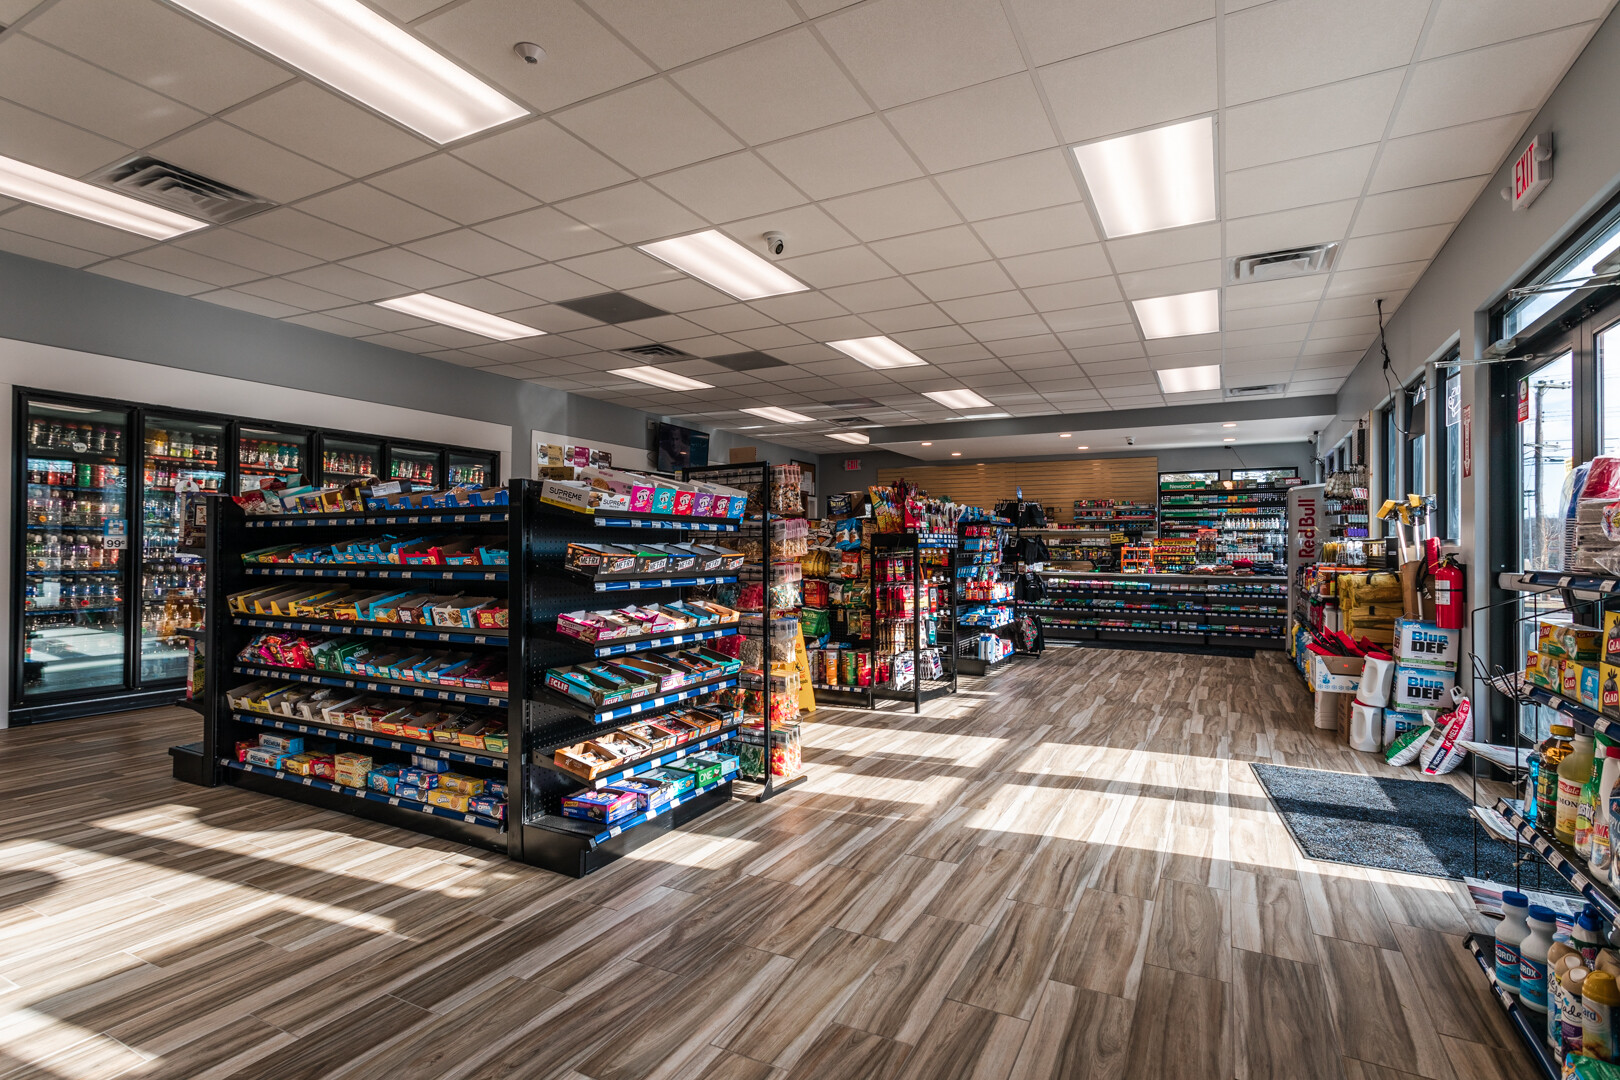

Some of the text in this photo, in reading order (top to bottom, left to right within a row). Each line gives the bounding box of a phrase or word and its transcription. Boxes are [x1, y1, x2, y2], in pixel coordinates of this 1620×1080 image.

[1515, 142, 1534, 200] EXIT
[847, 460, 858, 470] EXIT
[1169, 483, 1192, 491] Newport
[549, 486, 582, 501] SUPREME
[602, 499, 626, 507] SUPREME
[1298, 499, 1316, 558] Red Bull
[1412, 631, 1449, 645] Blue
[1540, 627, 1551, 637] GLAD
[1411, 641, 1447, 654] DEF
[1608, 639, 1620, 651] GLA
[1527, 656, 1537, 666] GLAD
[553, 679, 569, 692] CLIF
[1407, 676, 1445, 691] Blue
[1564, 678, 1576, 688] GLAD
[1407, 687, 1444, 700] DEF
[1603, 692, 1618, 702] GLAD
[1448, 725, 1460, 741] MELT
[263, 739, 281, 747] PREMIUM
[699, 770, 713, 782] ONE
[1582, 1008, 1597, 1021] ard
